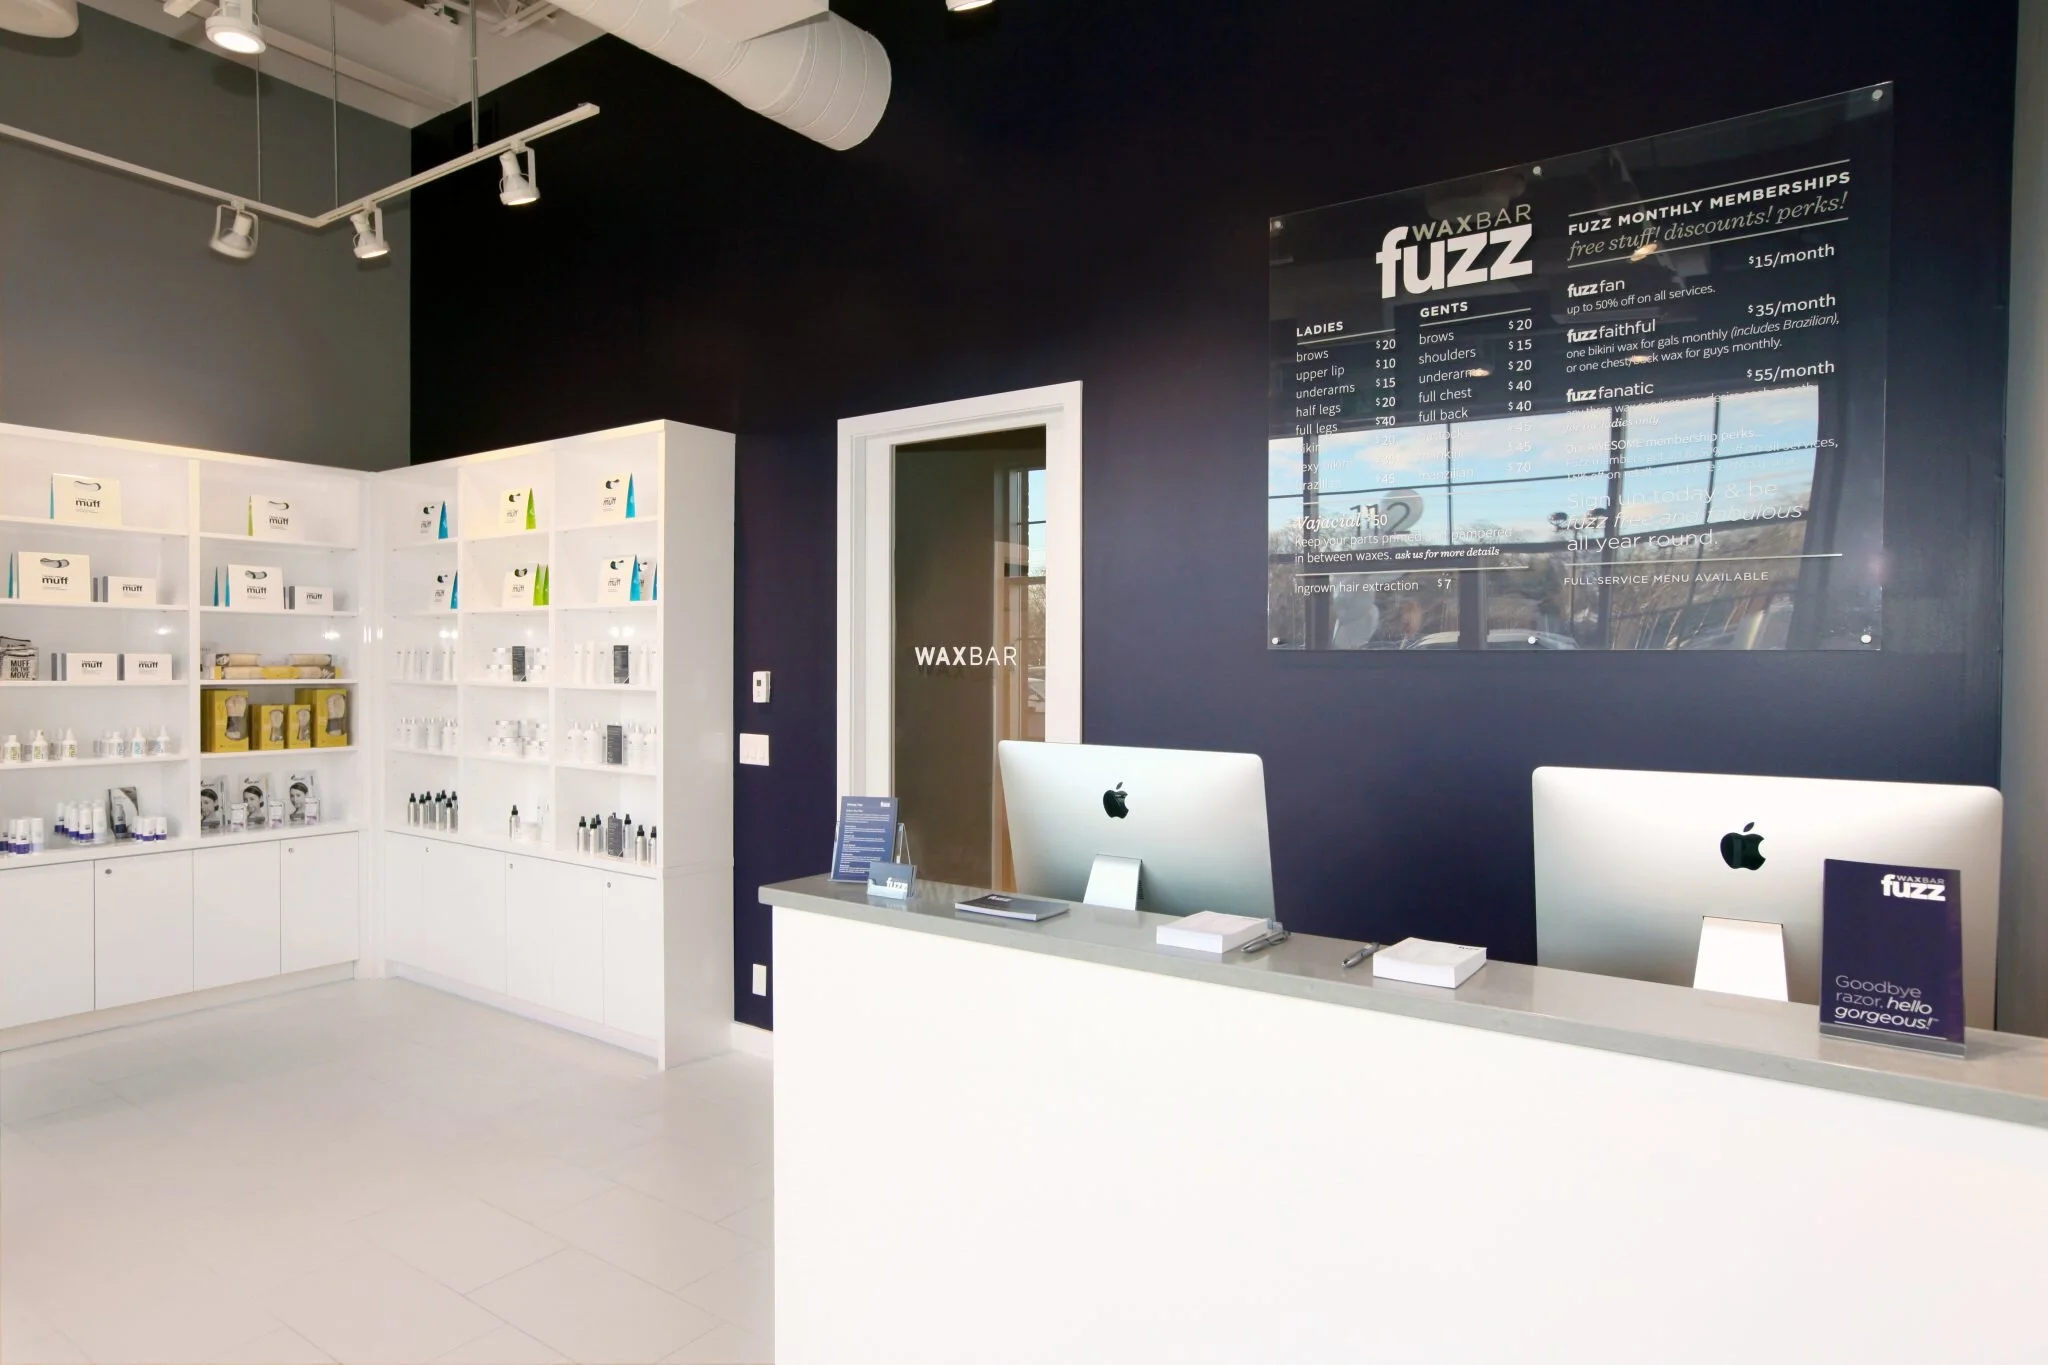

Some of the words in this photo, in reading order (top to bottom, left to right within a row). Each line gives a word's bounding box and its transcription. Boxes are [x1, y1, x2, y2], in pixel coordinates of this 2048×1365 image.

[1568, 217, 1612, 236] FUZZ
[1618, 200, 1704, 227] MONTHLY
[1709, 171, 1851, 209] MEMBERSHIPS
[1567, 240, 1605, 262] free
[1608, 226, 1661, 250] stuff!
[1664, 205, 1772, 242] discounts!
[1776, 191, 1848, 228] perks!
[1375, 223, 1533, 299] fuzz
[1567, 305, 1581, 316] up
[1582, 303, 1593, 313] to
[1595, 299, 1619, 311] 50%
[1620, 294, 1636, 307] off
[1637, 295, 1651, 305] on
[1654, 290, 1666, 302] all
[1668, 284, 1716, 300] services.
[1419, 301, 1469, 318] GENTS
[1296, 321, 1344, 338] LADIES
[1418, 332, 1455, 345] brows
[1566, 348, 1586, 360] one
[1588, 343, 1615, 357] bikini
[1617, 341, 1639, 352] wax
[1640, 338, 1655, 350] for
[1657, 335, 1680, 350] gals
[1682, 328, 1729, 344] monthly
[1730, 321, 1781, 340] (includes
[1782, 311, 1840, 331] Brazilian),
[1296, 350, 1329, 363] brows
[1418, 347, 1477, 365] shoulders
[1566, 364, 1577, 374] or
[1579, 361, 1599, 373] one
[1661, 350, 1683, 362] wax
[1685, 347, 1701, 360] for
[1703, 344, 1730, 360] guys
[1732, 337, 1783, 354] monthly.
[1296, 368, 1328, 383] upper
[1331, 365, 1345, 379] lip
[1295, 384, 1356, 399] underarms
[1418, 390, 1436, 404] full
[1439, 387, 1473, 402] chest
[1295, 404, 1316, 418] half
[1319, 403, 1341, 417] legs
[1418, 409, 1436, 423] full
[1440, 406, 1469, 421] back
[1295, 423, 1312, 436] full
[1316, 422, 1339, 436] legs
[75, 499, 101, 508] muff
[1568, 491, 1612, 511] Sign
[1617, 490, 1646, 508] up
[1652, 483, 1717, 504] today
[1749, 479, 1779, 497] be
[1297, 512, 1361, 532] Vajacial
[1566, 513, 1608, 531] fuzz
[1706, 503, 1803, 525] fabulous
[1323, 535, 1348, 549] your
[1350, 534, 1379, 548] parts
[1567, 535, 1588, 551] all
[1596, 535, 1641, 553] year
[1648, 528, 1719, 548] round.
[1295, 552, 1304, 564] in
[1307, 551, 1353, 563] between
[1355, 550, 1393, 562] waxes.
[1395, 549, 1411, 560] ask
[1412, 551, 1424, 559] us
[1423, 548, 1440, 561] for
[1440, 549, 1466, 558] more
[1466, 546, 1500, 558] details
[42, 576, 68, 585] muff
[1339, 581, 1360, 593] hair
[1362, 579, 1420, 593] extraction
[1564, 576, 1593, 586] FULL
[1597, 574, 1649, 585] SERVICE
[1653, 573, 1690, 583] MENU
[1694, 571, 1769, 582] AVAILABLE
[11, 659, 30, 667] MUFF
[914, 645, 1017, 667] WAXBAR
[10, 671, 30, 679] MOVE
[1880, 873, 1946, 902] fuzz
[1835, 974, 1922, 999] Goodbye
[1836, 991, 1884, 1009] razor.
[1886, 996, 1933, 1014] hello
